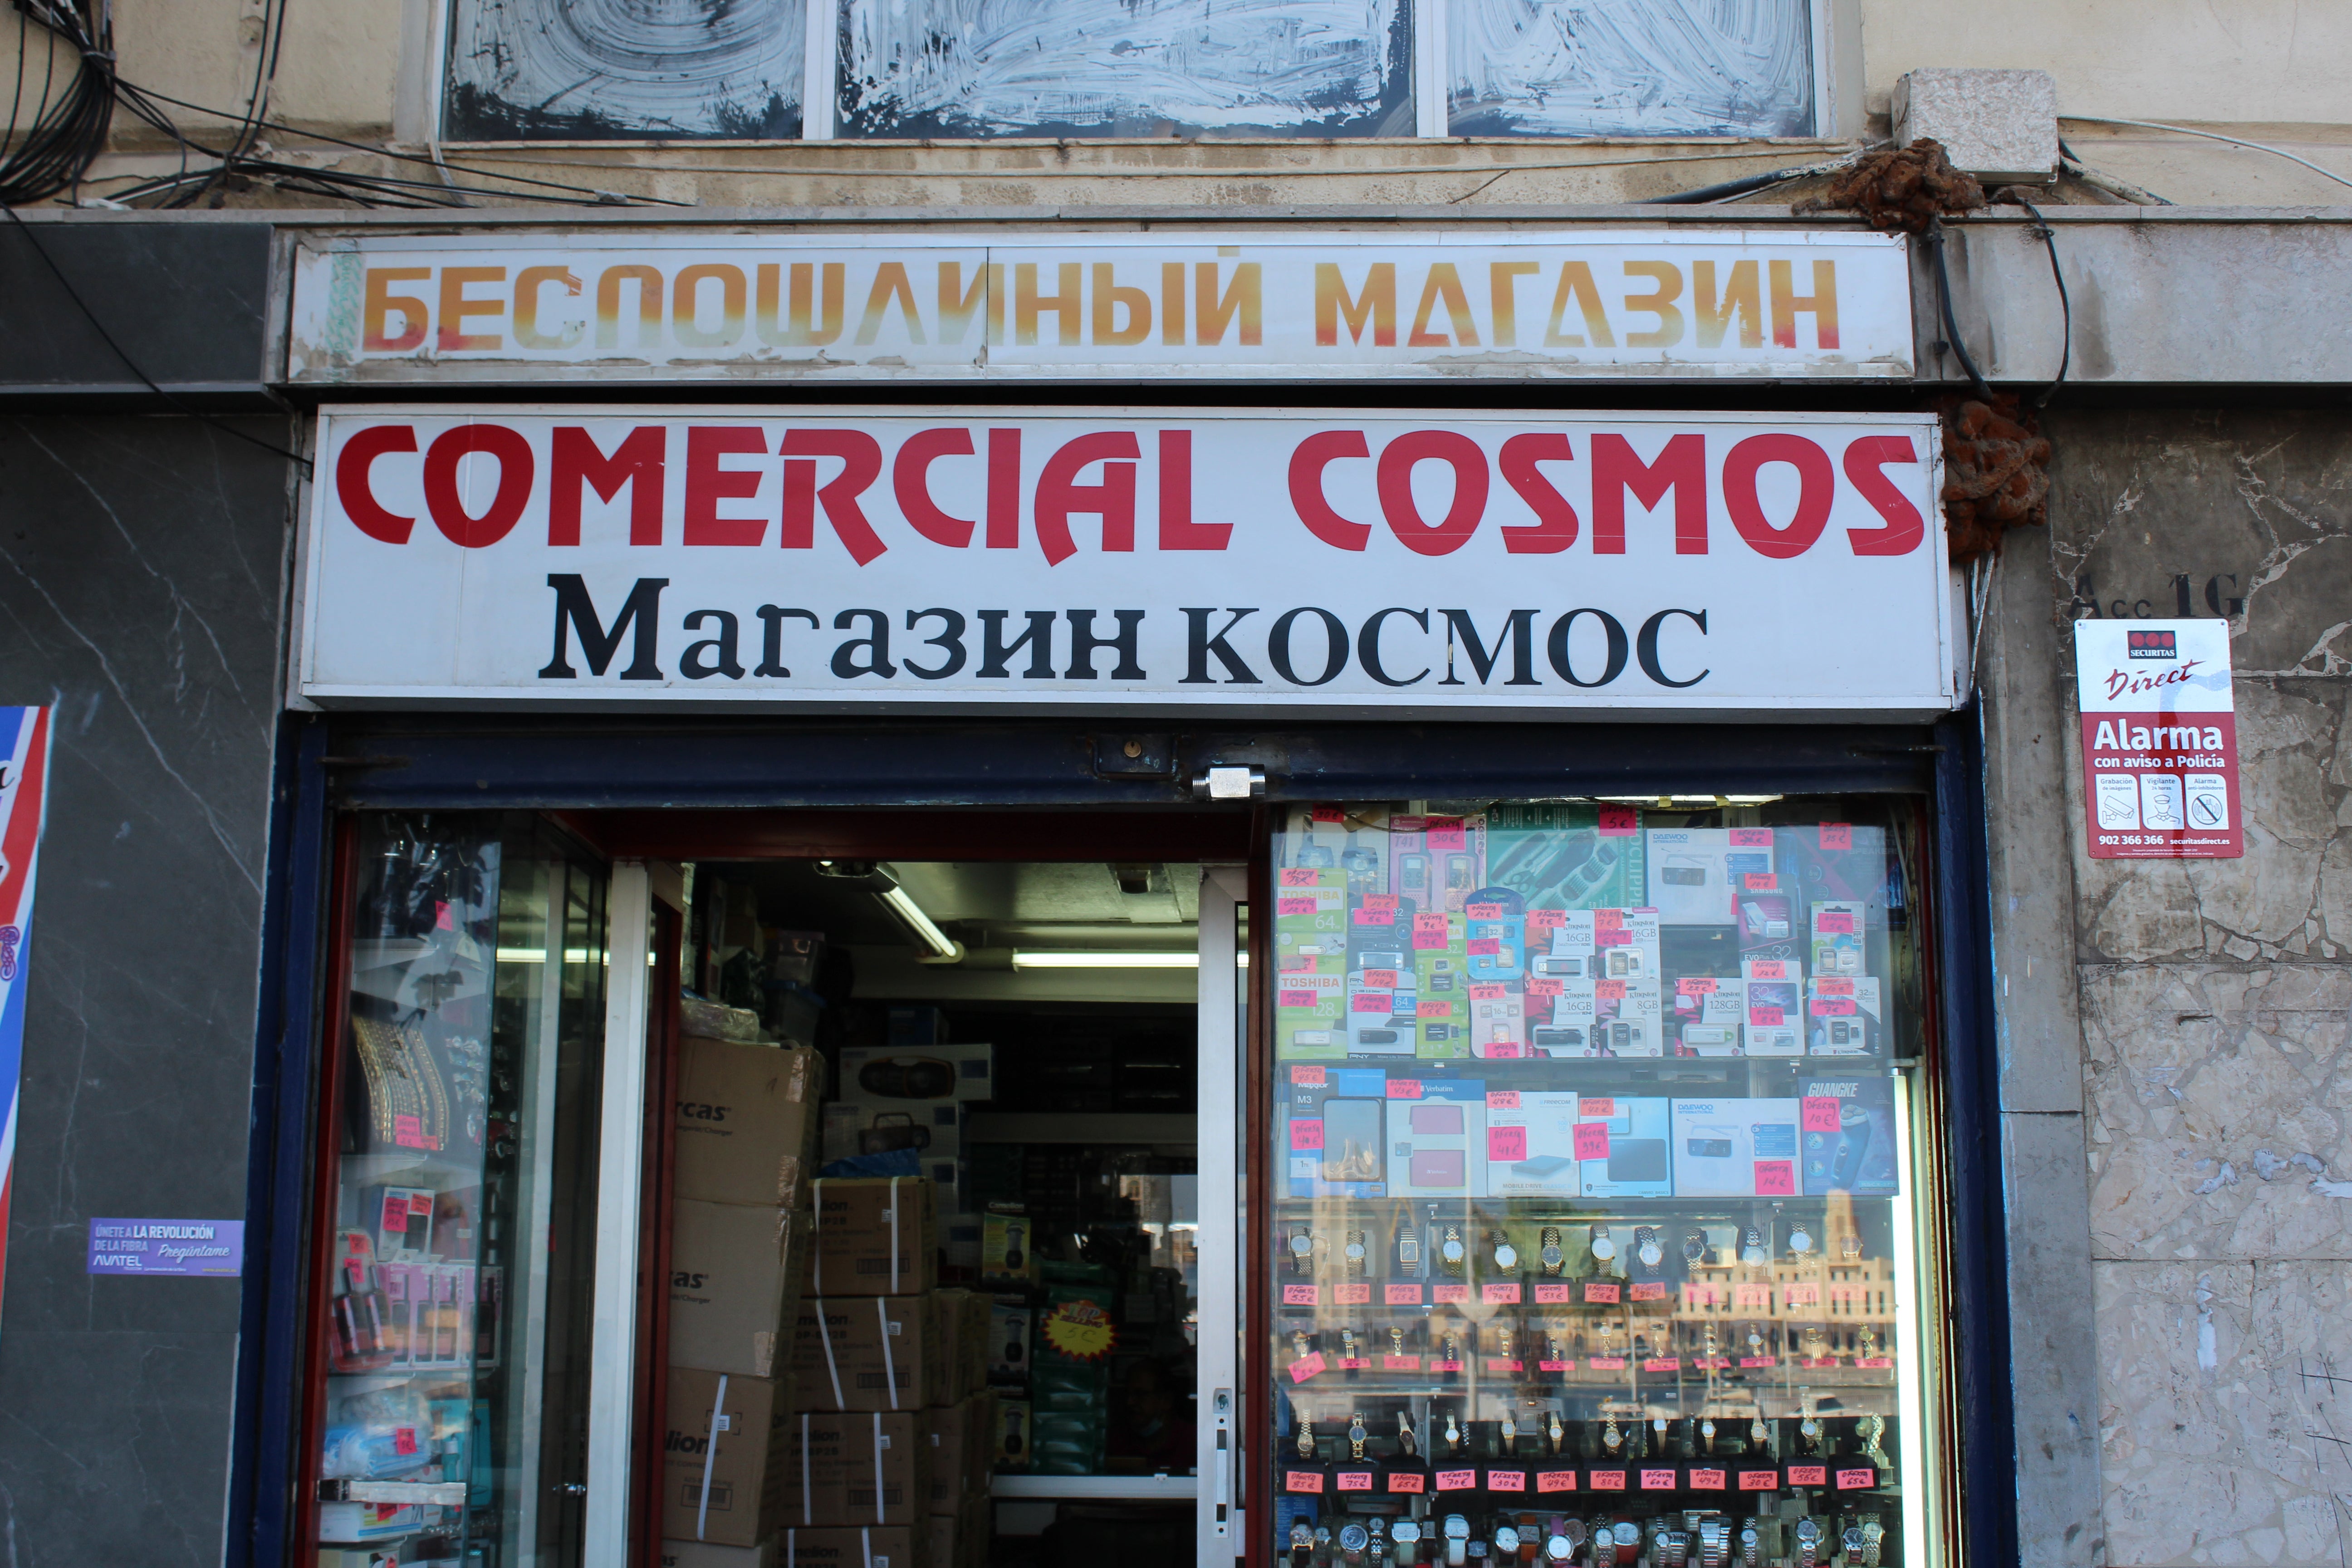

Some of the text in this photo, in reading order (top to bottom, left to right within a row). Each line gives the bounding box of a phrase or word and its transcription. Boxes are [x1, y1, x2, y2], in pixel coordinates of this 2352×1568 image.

[362, 246, 1840, 352] БЕСПОШЛИНЫЙ МАГАЗИН
[336, 424, 1925, 568] COMERCIAL COSMOS
[538, 573, 1146, 681] Магазин
[2130, 649, 2175, 657] SECURITAS
[2103, 659, 2206, 701] Direct
[2093, 719, 2224, 751] Alarma
[2094, 753, 2225, 769] con aviso a Policía
[1395, 836, 1413, 847] T41
[2098, 835, 2164, 845] 902 366 366
[1282, 891, 1340, 900] TOSHIBA
[1566, 933, 1591, 942] 16GB
[1632, 929, 1656, 937] 16GB
[1772, 946, 1791, 961] 32
[1282, 978, 1339, 987] TOSHIBA
[1751, 986, 1769, 1000] 32
[1566, 1002, 1592, 1010] 16GB
[1637, 1000, 1658, 1009] 8GB
[1710, 1001, 1740, 1009] 128GB
[1808, 1083, 1858, 1097] GUANGKE
[1297, 1095, 1312, 1103] M3
[95, 1224, 215, 1240] ÚNETE A LA REVOLUCIÓN
[94, 1240, 149, 1252] DE LA FIBRA
[93, 1254, 142, 1267] AVATEL
[157, 1244, 231, 1264] Pregúntame
[1059, 1314, 1103, 1329] SELLING
